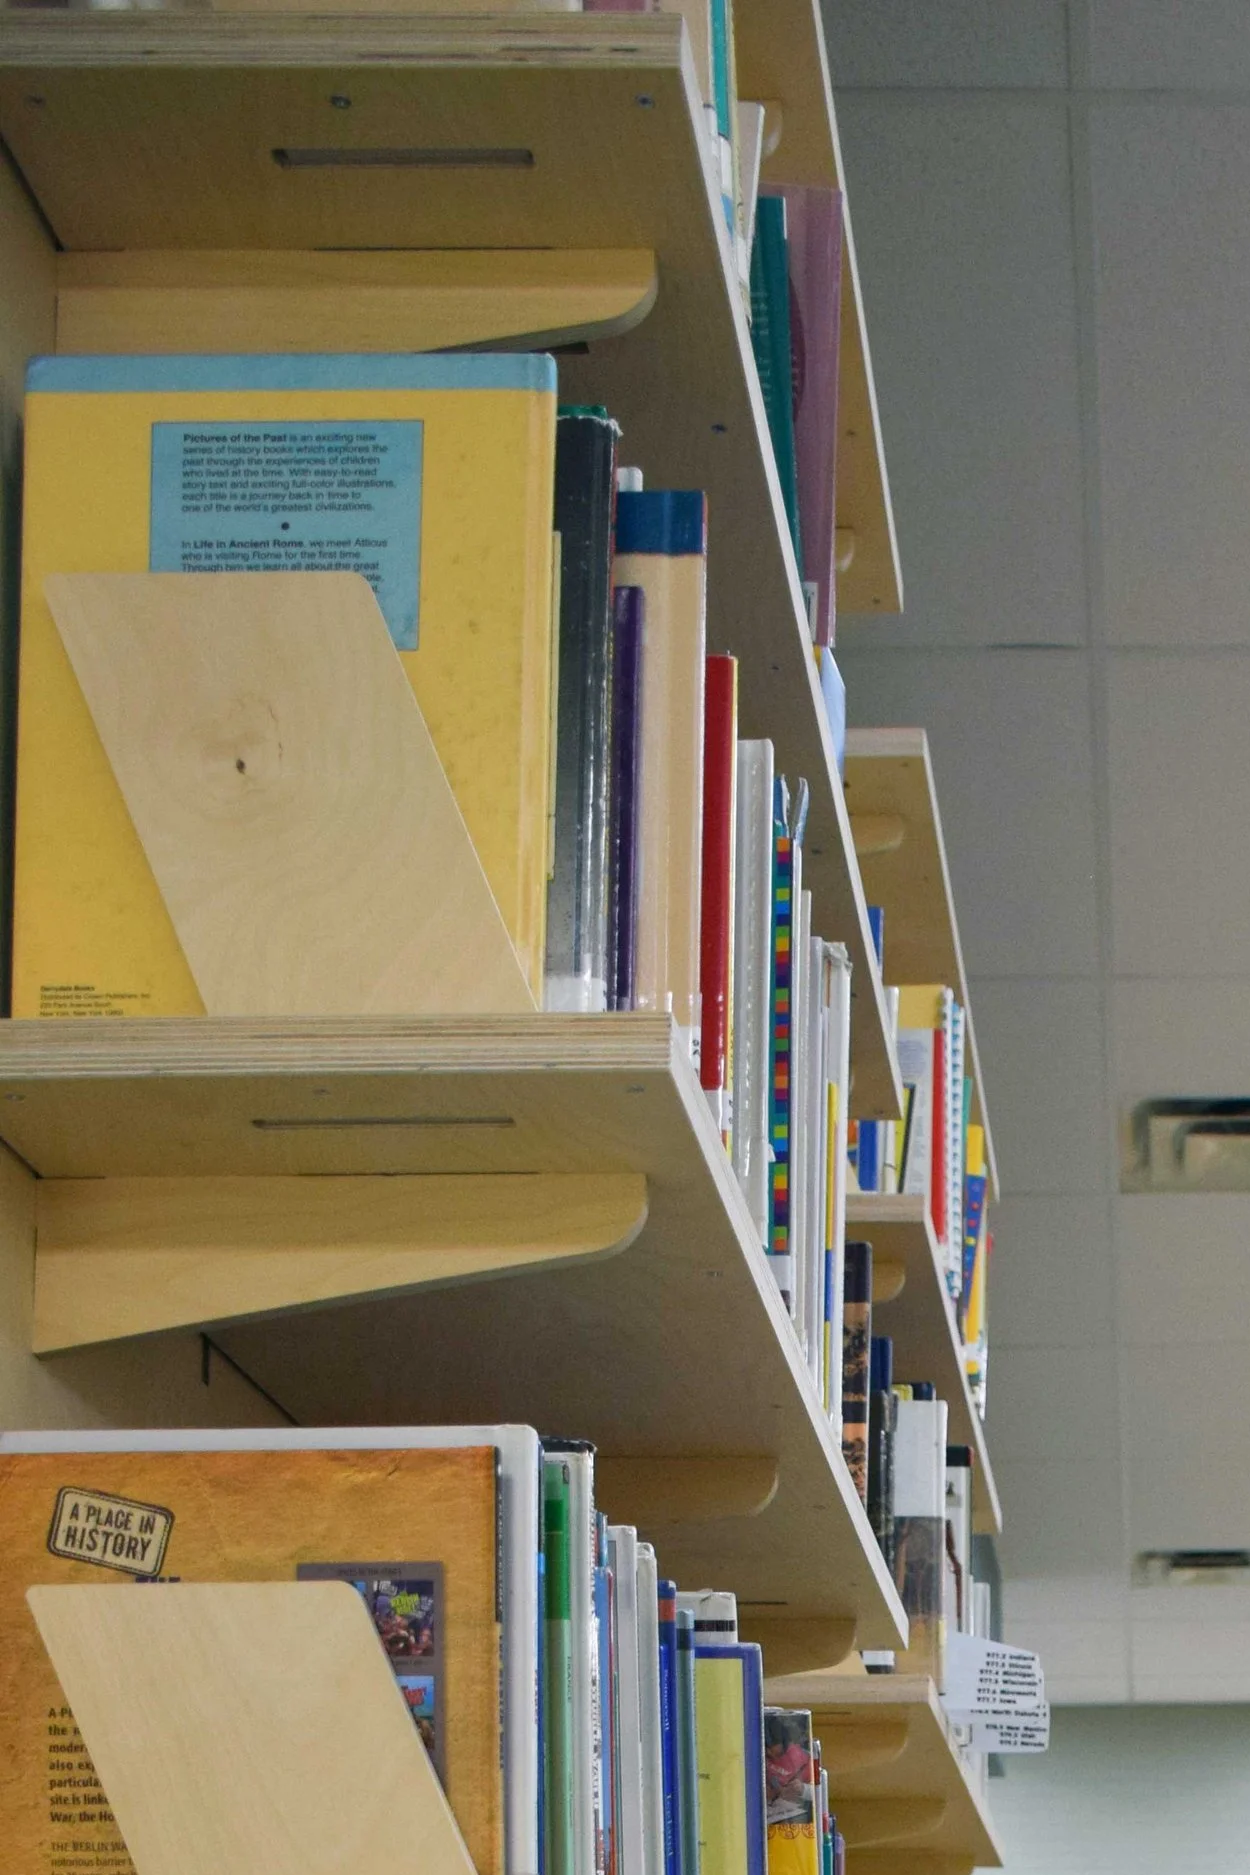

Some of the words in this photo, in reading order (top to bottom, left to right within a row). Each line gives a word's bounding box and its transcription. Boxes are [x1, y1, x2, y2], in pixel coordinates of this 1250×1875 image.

[184, 433, 227, 442] Pictures
[230, 433, 241, 442] of
[244, 433, 260, 442] the
[263, 433, 287, 442] Past
[244, 468, 259, 477] the
[216, 502, 231, 511] the
[193, 540, 213, 549] Life
[217, 540, 226, 549] in
[229, 540, 270, 549] Ancient
[300, 551, 316, 560] the
[70, 1502, 80, 1521] A
[85, 1505, 133, 1530] PLACE
[139, 1514, 157, 1535] IN
[64, 1525, 152, 1562] HISTORY
[48, 1708, 57, 1718] A
[48, 1724, 67, 1735] the
[49, 1760, 73, 1770] also
[50, 1794, 69, 1805] site
[72, 1794, 81, 1804] is
